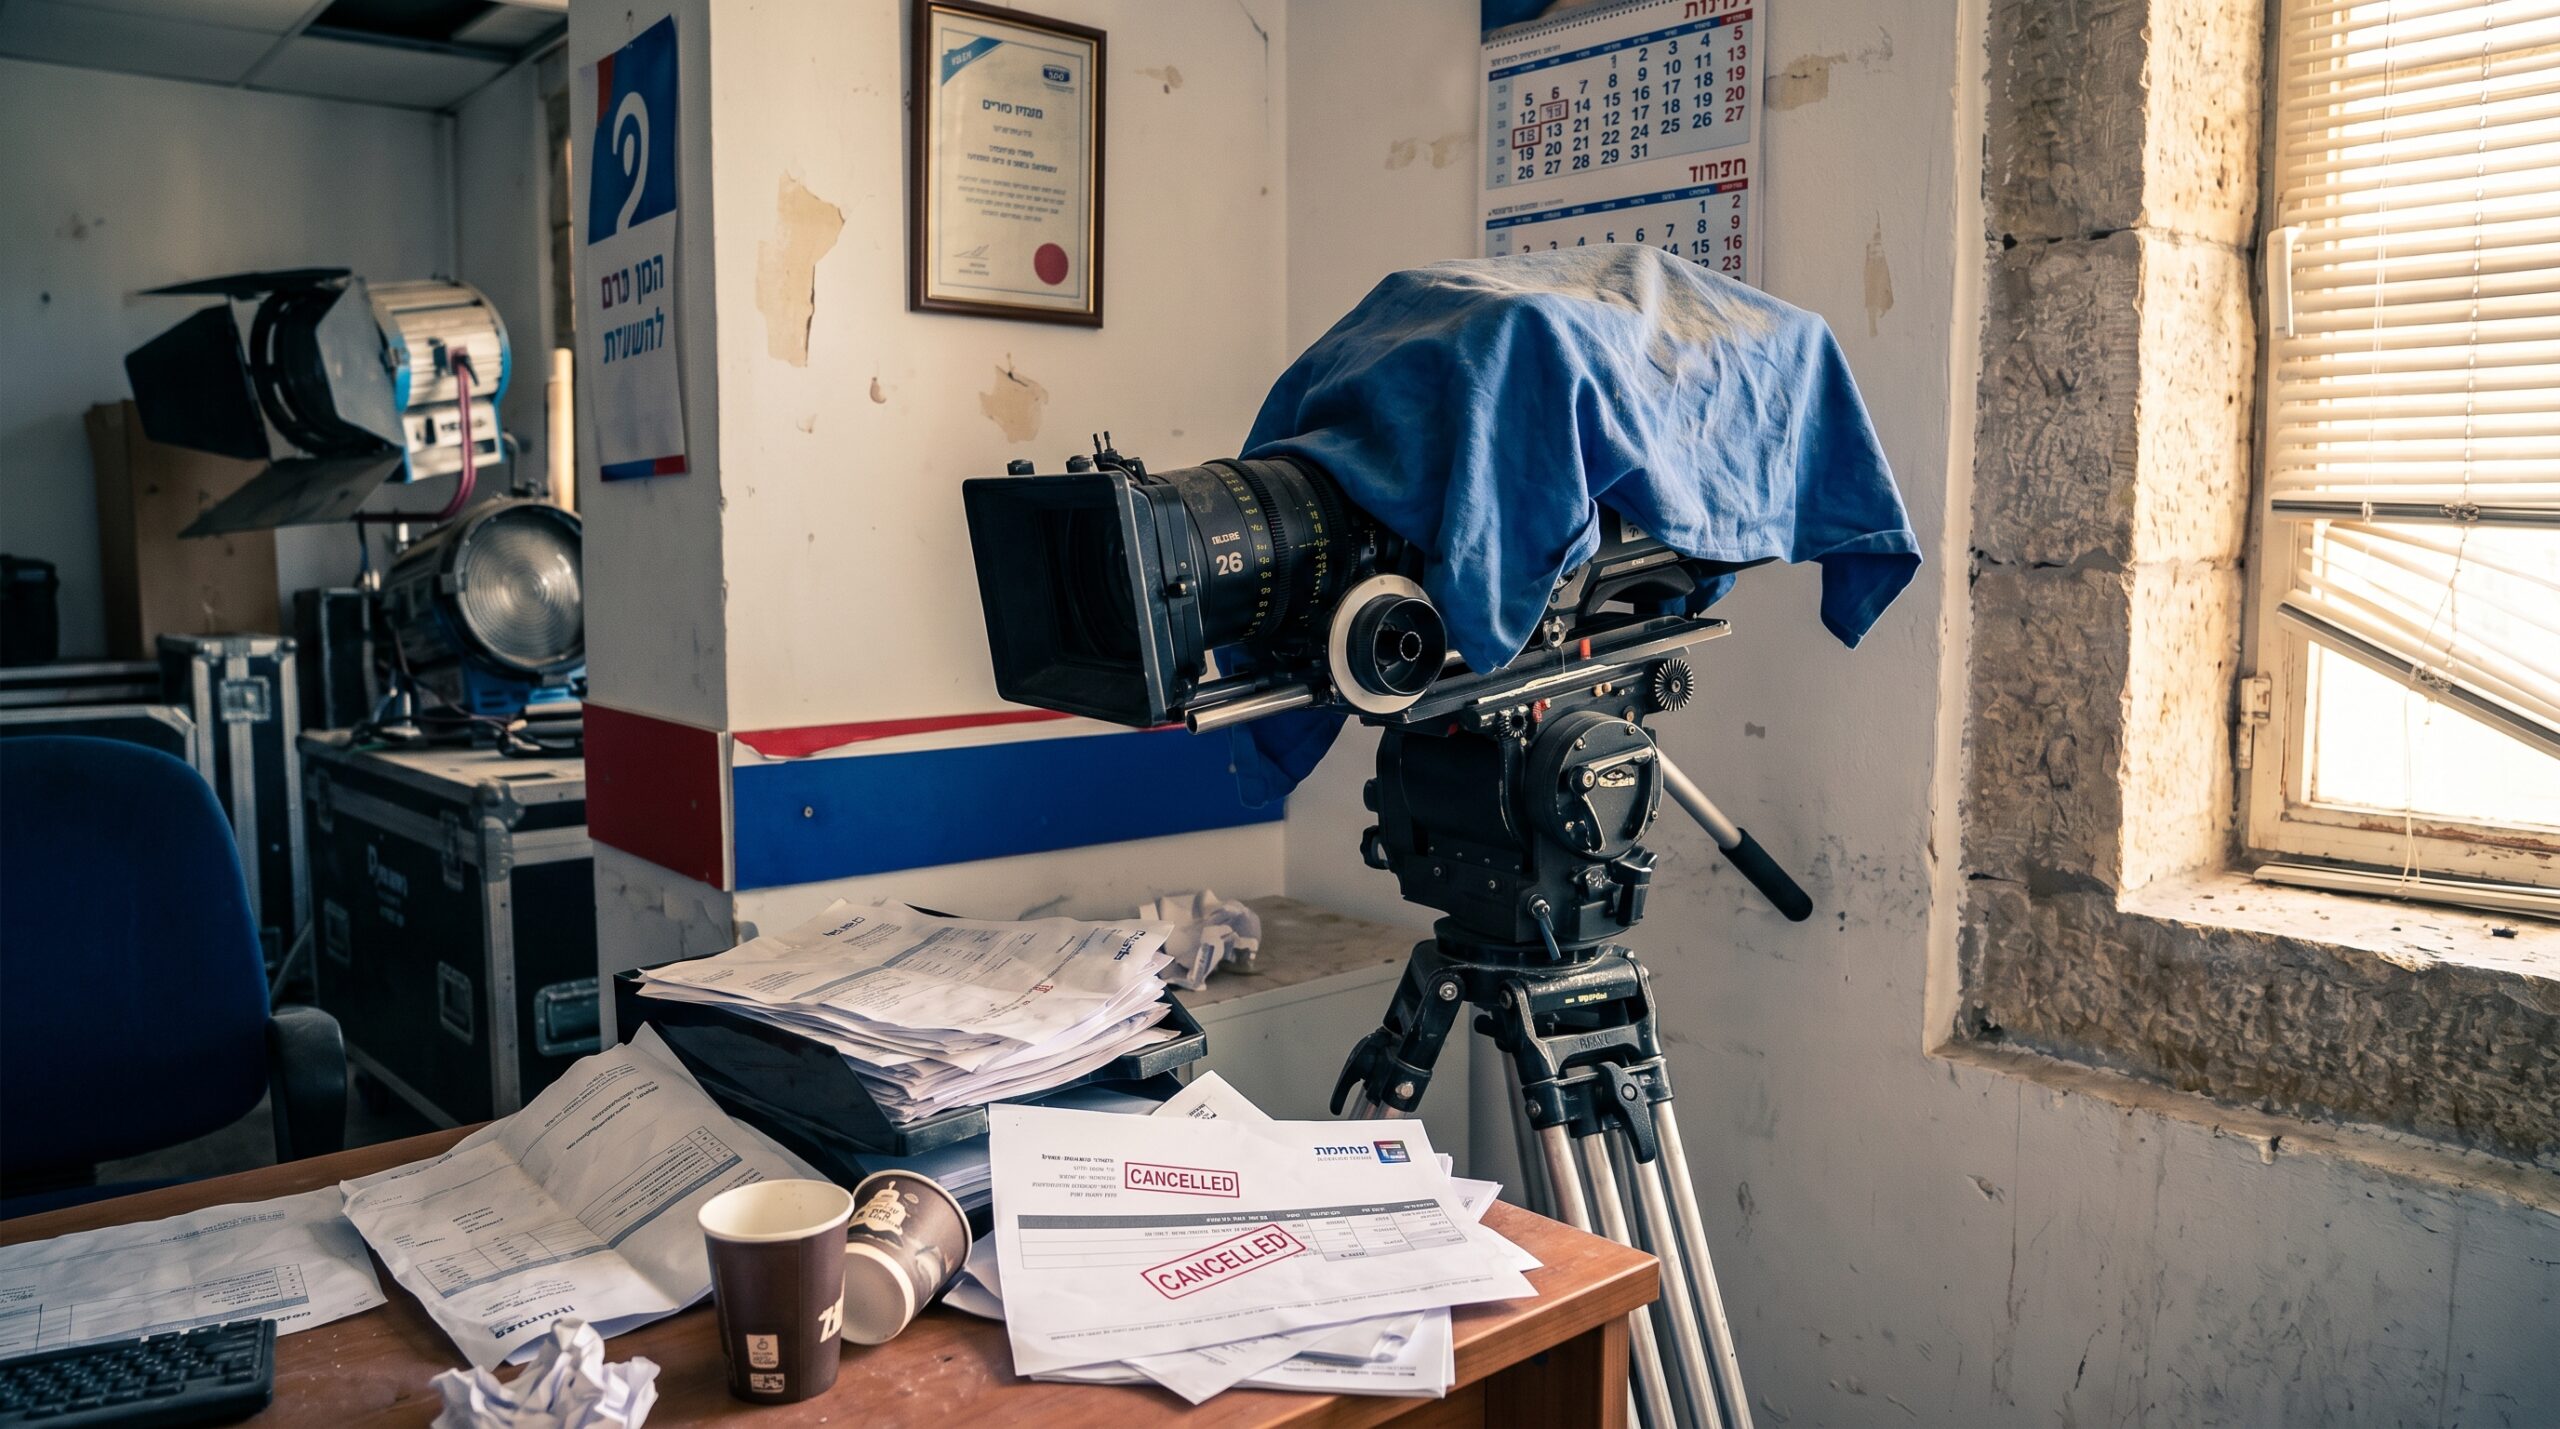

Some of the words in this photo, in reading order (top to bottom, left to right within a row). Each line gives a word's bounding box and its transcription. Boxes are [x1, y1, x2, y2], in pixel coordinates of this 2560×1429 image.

[1639, 47, 1648, 62] 2
[1668, 40, 1677, 55] 3
[1701, 33, 1710, 47] 4
[1734, 25, 1743, 40] 5
[1525, 93, 1533, 106] 5
[1608, 73, 1617, 88] 8
[1638, 67, 1647, 81] 9
[1663, 59, 1681, 75] 10
[1728, 45, 1746, 61] 13
[1520, 110, 1535, 125] 12
[1574, 98, 1591, 113] 14
[1603, 92, 1620, 108] 15
[1632, 86, 1650, 101] 16
[1662, 79, 1681, 95] 17
[1694, 72, 1713, 88] 18
[1726, 65, 1745, 82] 19
[1546, 123, 1562, 138] 13
[1573, 117, 1589, 132] 21
[1603, 111, 1620, 127] 12
[1632, 105, 1649, 121] 17
[1662, 98, 1680, 115] 18
[1694, 92, 1712, 108] 19
[1725, 85, 1745, 102] 20
[1519, 147, 1534, 161] 19
[1545, 141, 1562, 157] 20
[1573, 135, 1589, 151] 21
[1601, 129, 1620, 146] 22
[1631, 124, 1649, 140] 24
[1661, 118, 1680, 135] 25
[1692, 112, 1712, 129] 26
[1725, 105, 1745, 122] 27
[1518, 164, 1534, 180] 26
[1545, 159, 1561, 175] 27
[1573, 154, 1590, 170] 28
[1601, 148, 1619, 165] 29
[1631, 143, 1648, 159] 31
[1699, 200, 1705, 214] 1
[1732, 194, 1740, 209] 2
[1636, 228, 1645, 242] 6
[1666, 224, 1675, 238] 7
[1697, 219, 1706, 234] 8
[1731, 215, 1740, 229] 9
[1692, 239, 1709, 255] 15
[1724, 234, 1742, 251] 16
[1722, 255, 1741, 271] 23
[1215, 551, 1244, 576] 26
[1130, 1168, 1234, 1192] CANCELLED
[1158, 1232, 1289, 1291] CANCELLED
